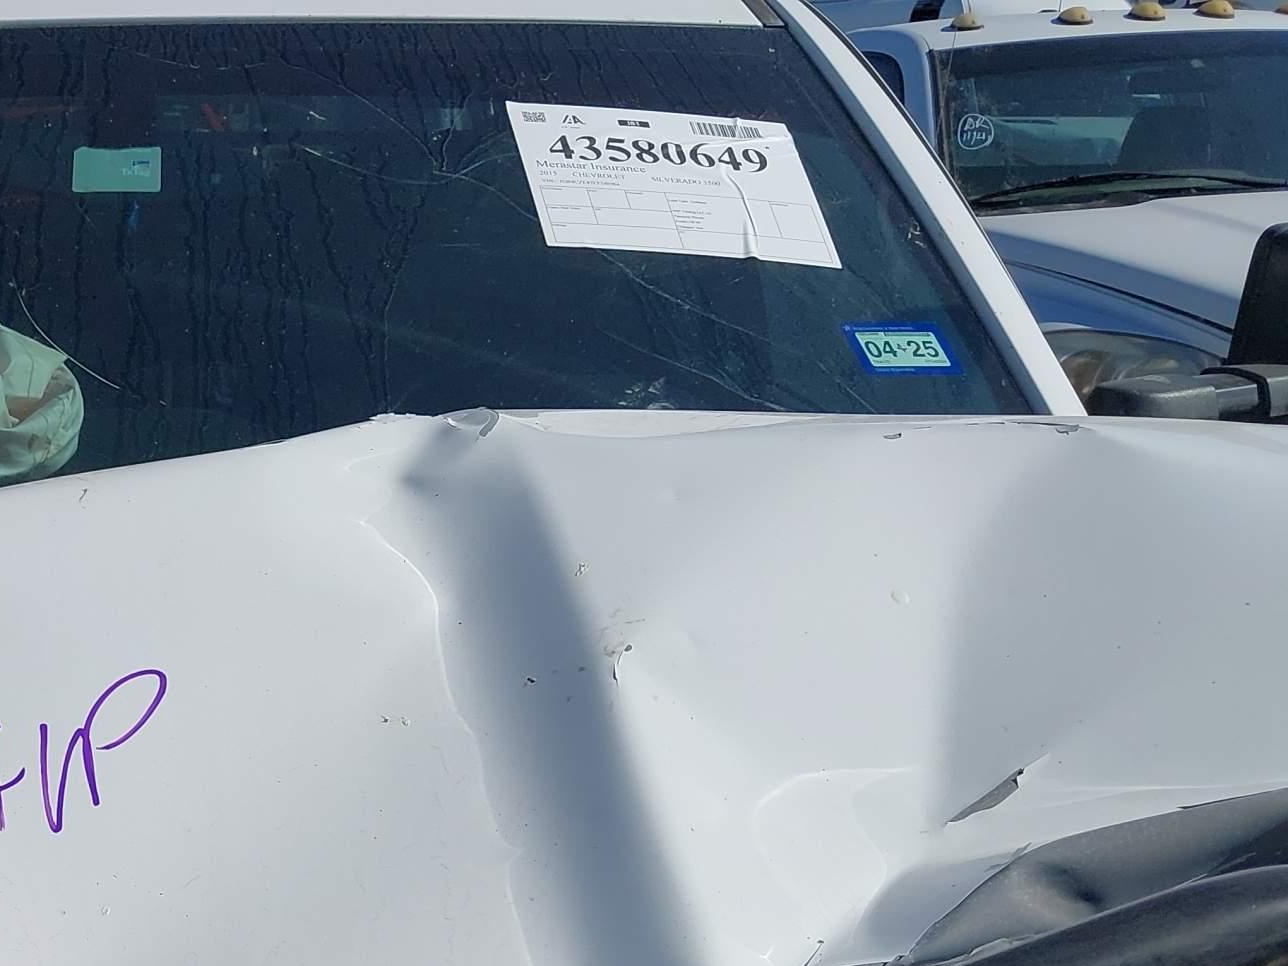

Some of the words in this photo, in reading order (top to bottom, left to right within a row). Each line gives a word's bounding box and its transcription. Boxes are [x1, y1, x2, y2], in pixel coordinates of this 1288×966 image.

[536, 160, 588, 170] Merastar
[591, 162, 647, 173] Insurance
[549, 135, 768, 173] 43580649
